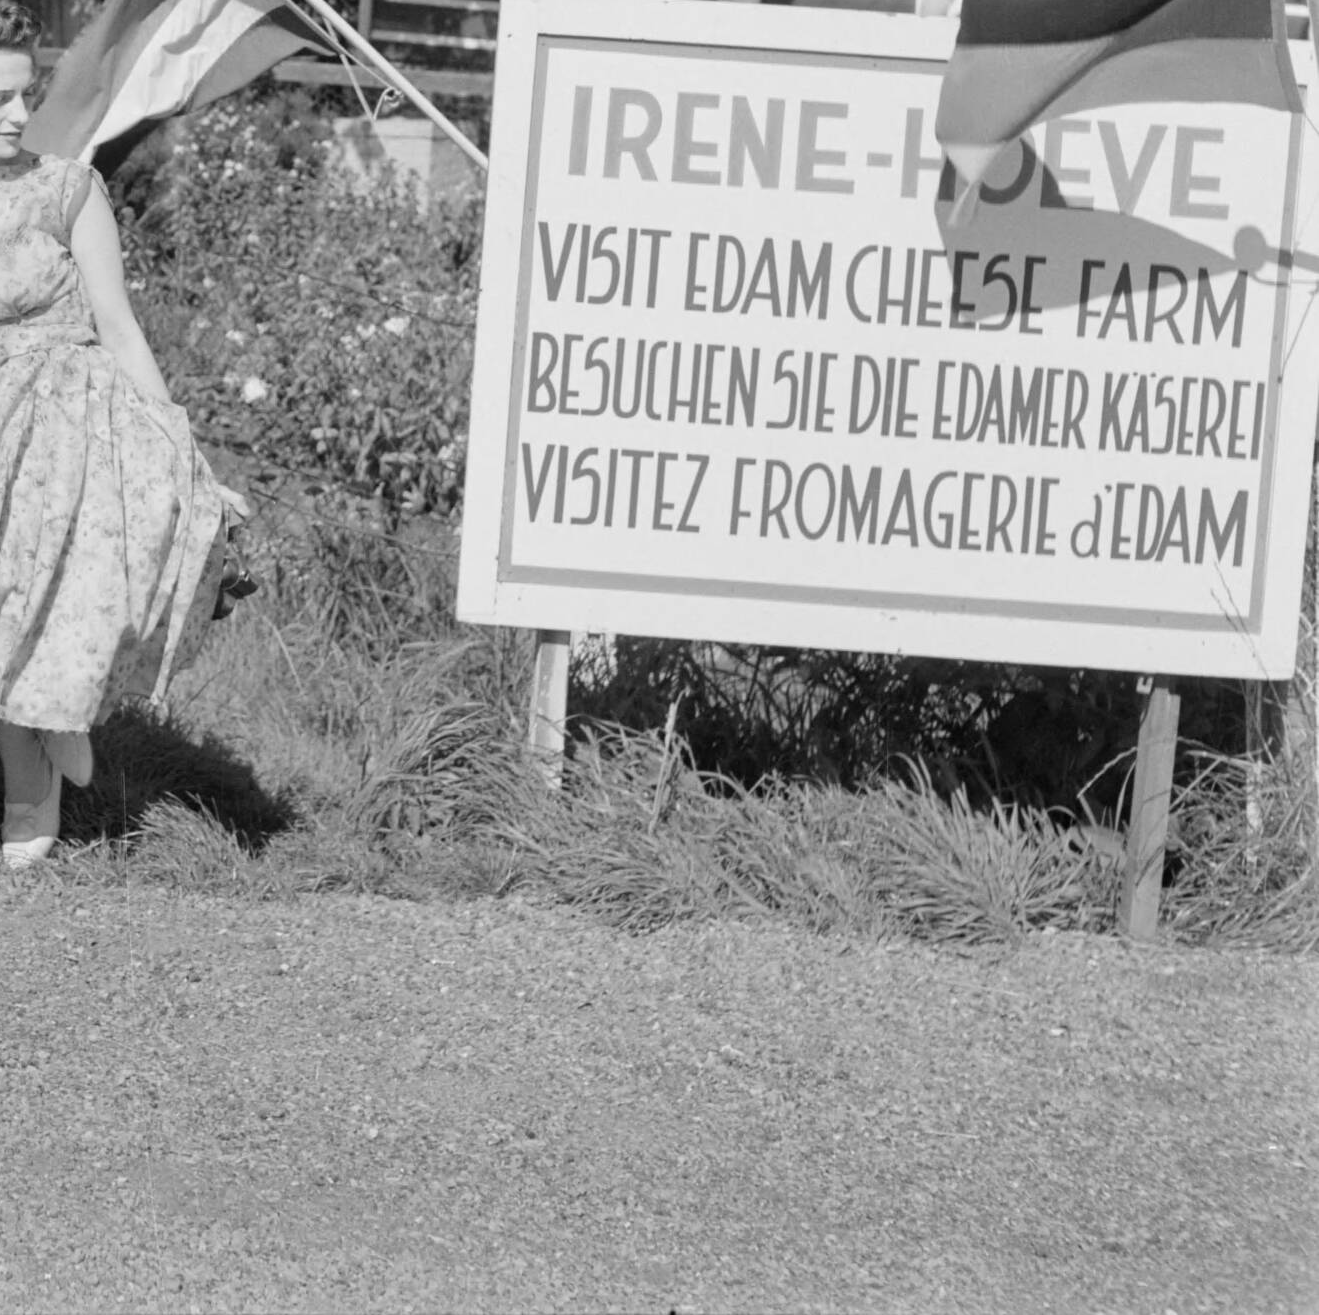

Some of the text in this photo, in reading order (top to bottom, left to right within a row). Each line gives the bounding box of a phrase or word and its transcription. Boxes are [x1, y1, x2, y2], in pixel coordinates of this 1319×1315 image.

[537, 221, 1248, 348] VISIT EDAM CHEESE FARM
[526, 332, 1265, 460] BESUCHEN SIE DIE EDAMER KÄSEREI
[521, 443, 1249, 567] VISITEZ FROMAGERIE d'EDAM
